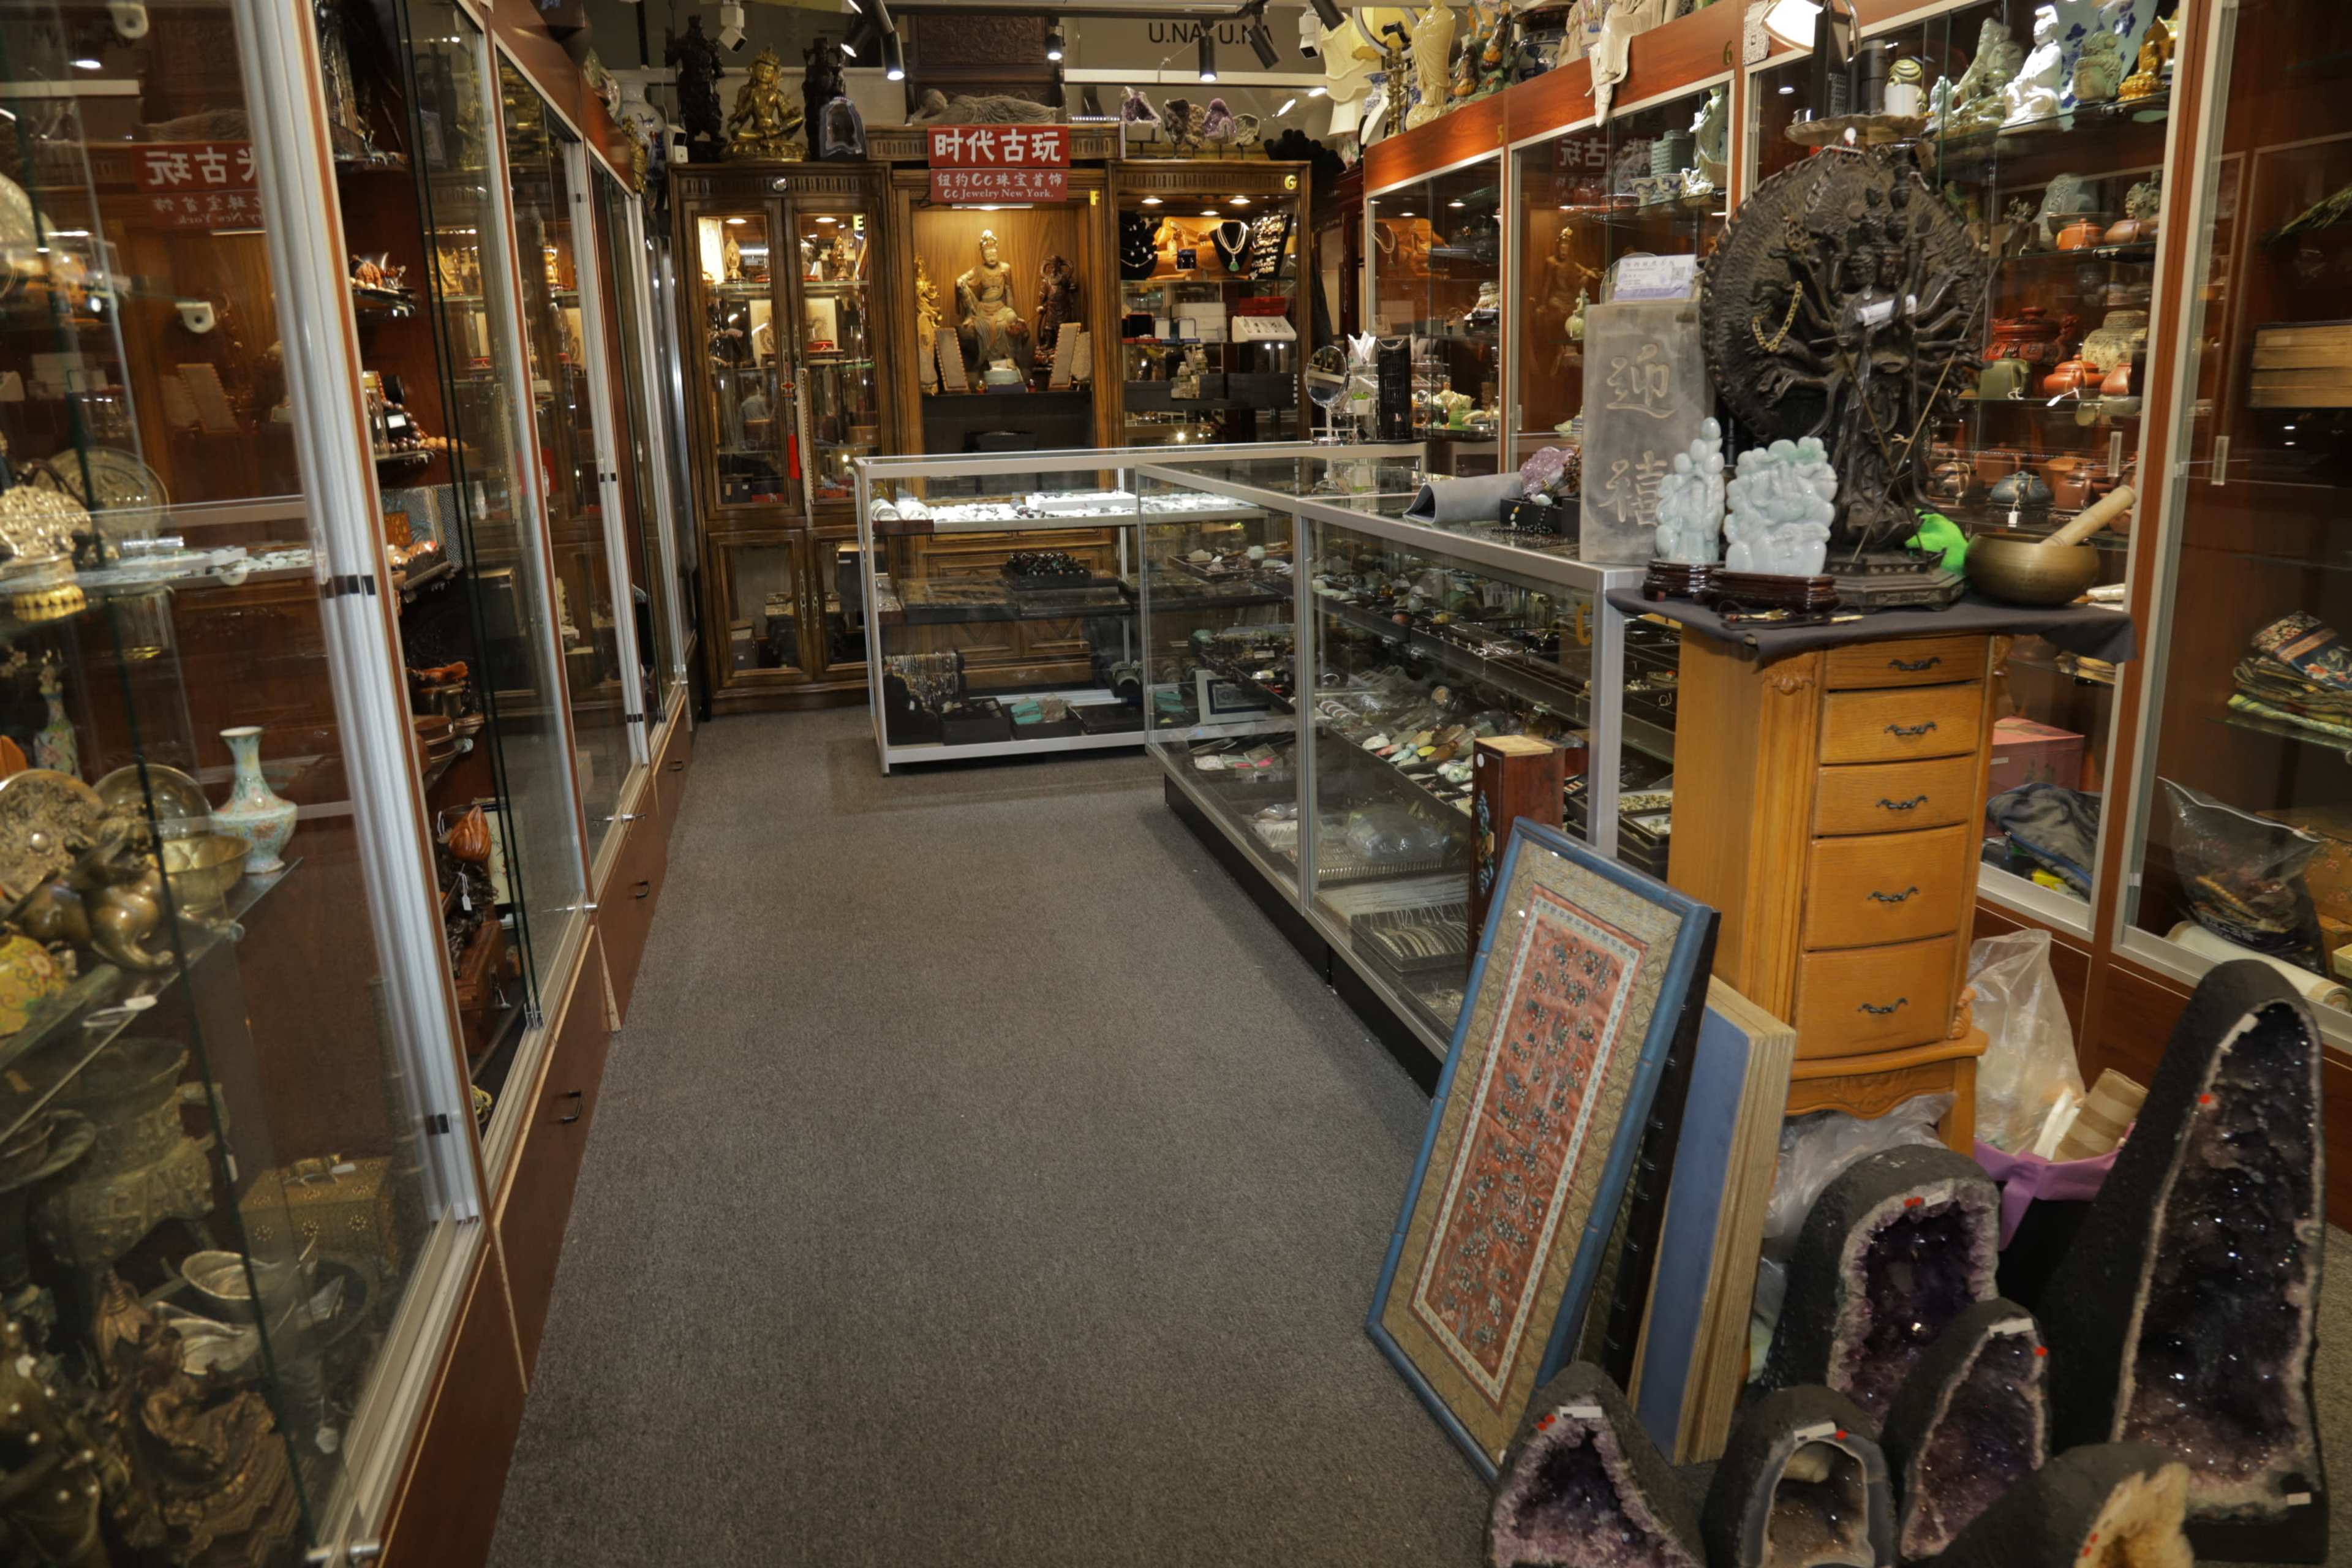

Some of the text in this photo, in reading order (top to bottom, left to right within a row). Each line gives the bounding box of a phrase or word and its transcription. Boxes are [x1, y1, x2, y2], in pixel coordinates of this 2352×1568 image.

[1722, 40, 1733, 65] 6
[935, 128, 1061, 162] 时代古玩
[1284, 175, 1297, 190] G
[960, 189, 999, 200] Jewelry
[1001, 189, 1023, 198] New
[1027, 189, 1054, 198] York.
[1090, 190, 1100, 206] F
[853, 214, 864, 230] E
[1577, 604, 1592, 646] C
